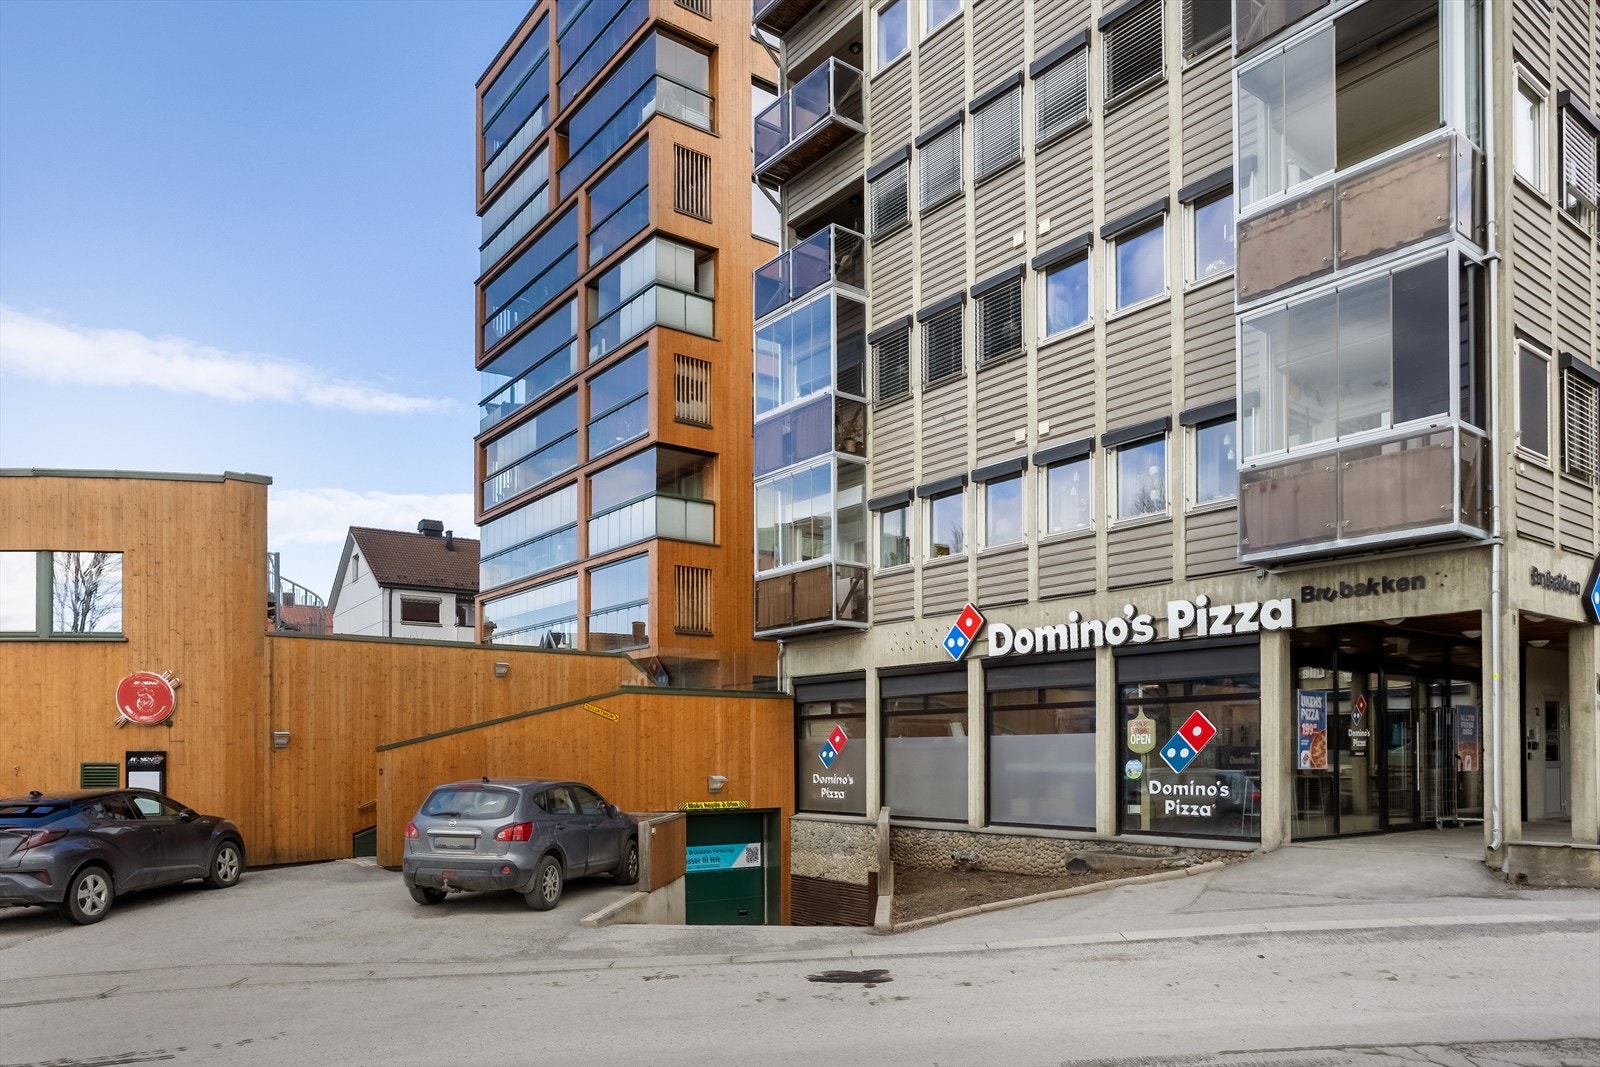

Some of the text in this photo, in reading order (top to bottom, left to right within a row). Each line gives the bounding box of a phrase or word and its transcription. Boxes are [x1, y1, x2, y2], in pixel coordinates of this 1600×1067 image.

[1300, 574, 1426, 603] Brubakken
[988, 594, 1295, 657] Domino's Pizza
[1300, 708, 1320, 721] PIZZA
[1130, 733, 1151, 745] OPEN
[1348, 728, 1370, 737] Domino's
[813, 773, 854, 785] Domino's
[821, 787, 845, 799] Pizza
[1149, 780, 1230, 797] Domino's
[1165, 799, 1212, 817] Pizza
